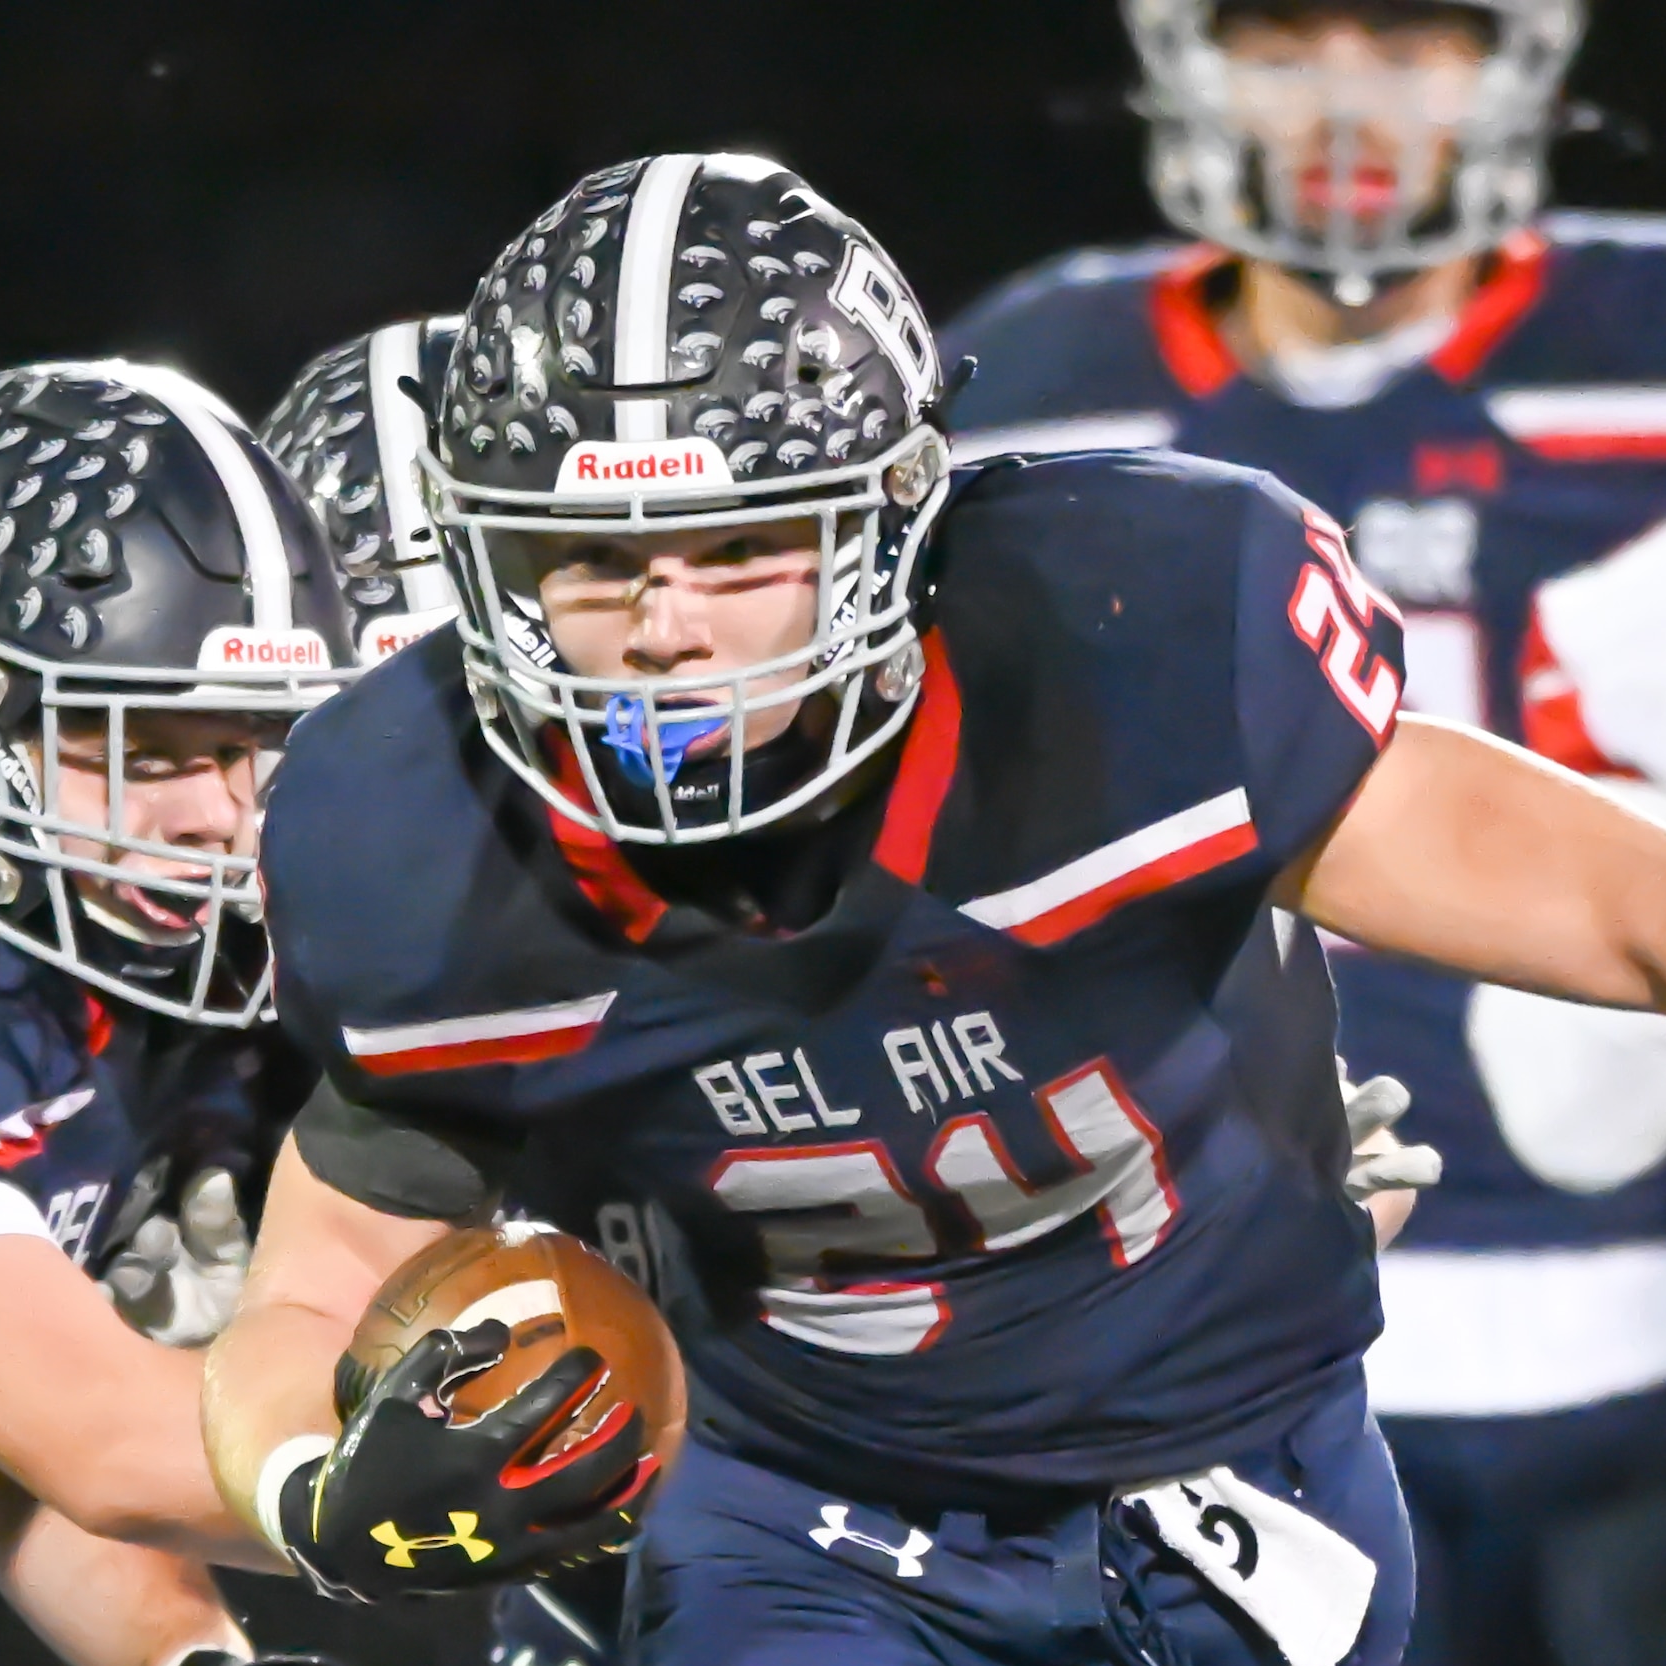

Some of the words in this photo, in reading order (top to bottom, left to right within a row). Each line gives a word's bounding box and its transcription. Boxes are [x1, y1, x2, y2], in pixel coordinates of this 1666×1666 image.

[577, 452, 704, 480] Riddell
[223, 637, 320, 665] Riddell
[693, 1047, 861, 1137] BEL
[882, 1010, 1024, 1114] AIR
[707, 1055, 1181, 1356] 24
